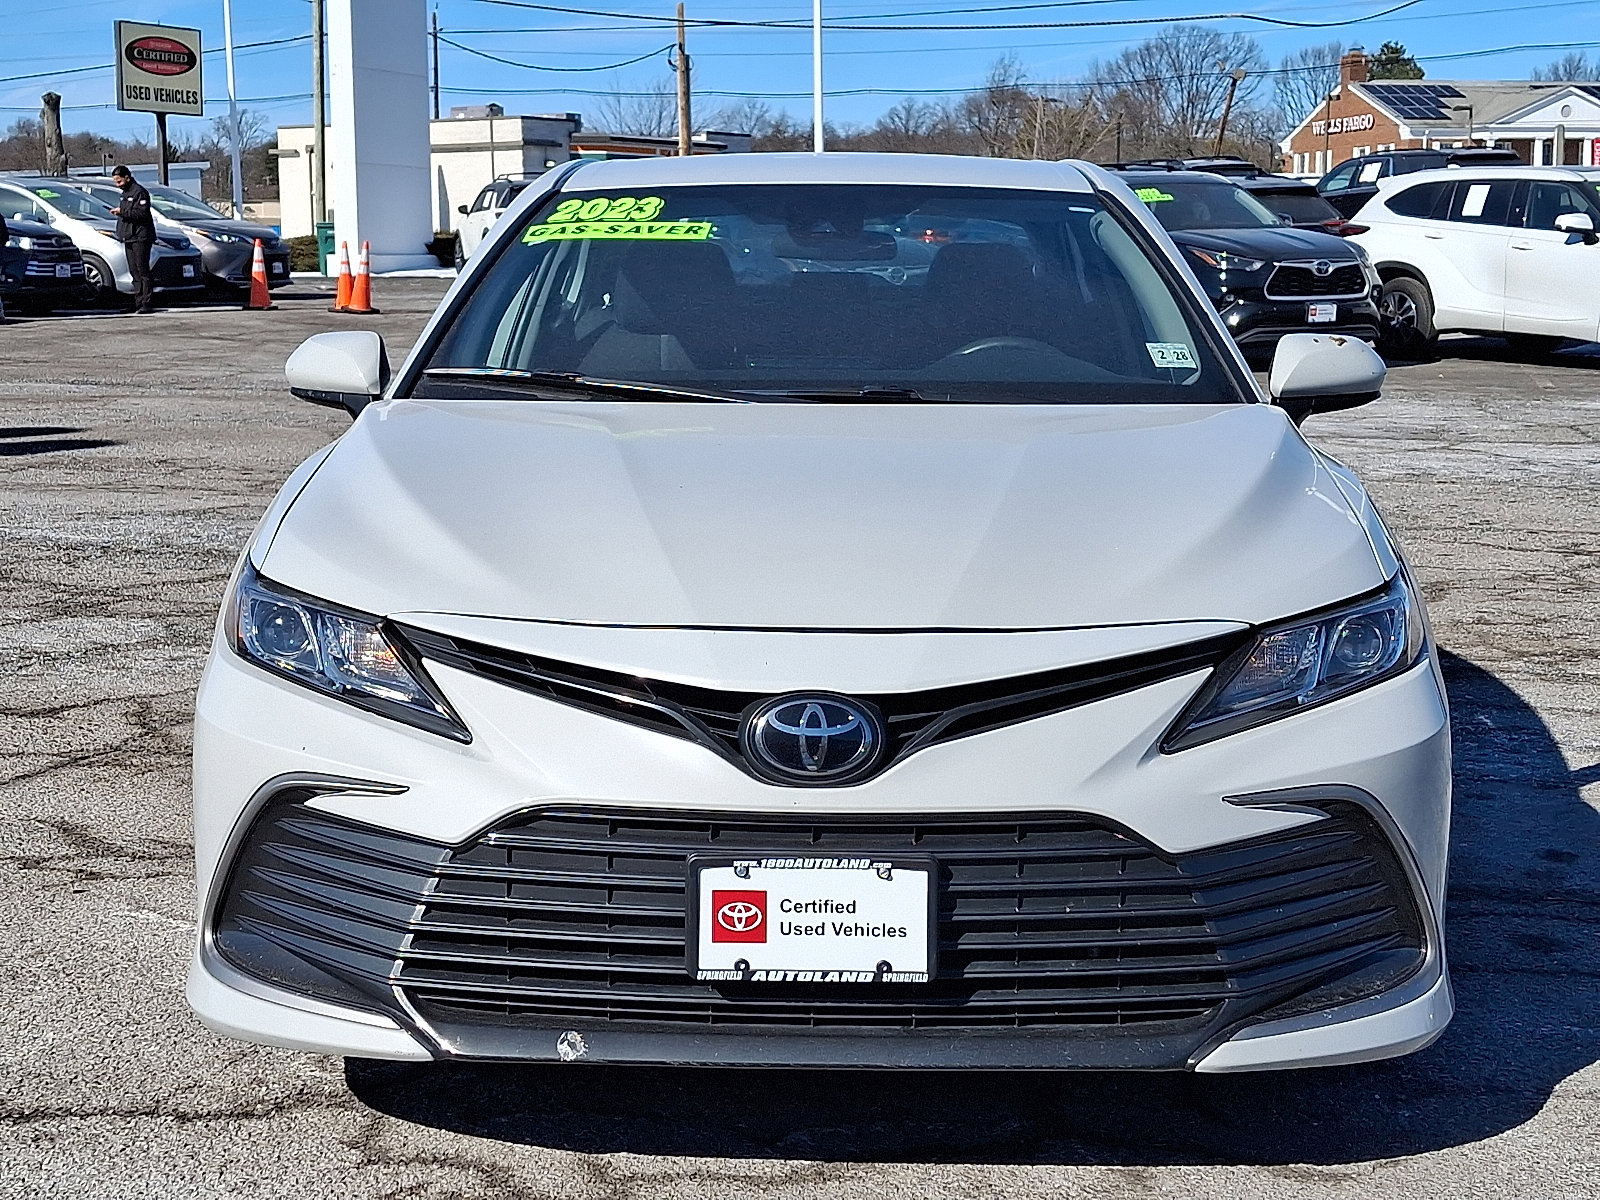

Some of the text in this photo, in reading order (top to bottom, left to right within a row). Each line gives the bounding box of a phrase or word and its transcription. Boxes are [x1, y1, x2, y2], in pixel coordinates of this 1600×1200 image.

[126, 85, 199, 105] USED VEHICLES
[1343, 113, 1374, 132] FARGO
[547, 196, 665, 222] 2023
[529, 225, 704, 237] GAS-SAVER
[1158, 350, 1188, 360] 2 28
[779, 898, 857, 914] Certified
[779, 921, 907, 938] Used Vehicles
[696, 970, 929, 983] SPRINGFIELD AUTOLAND SPRINGFIELD
